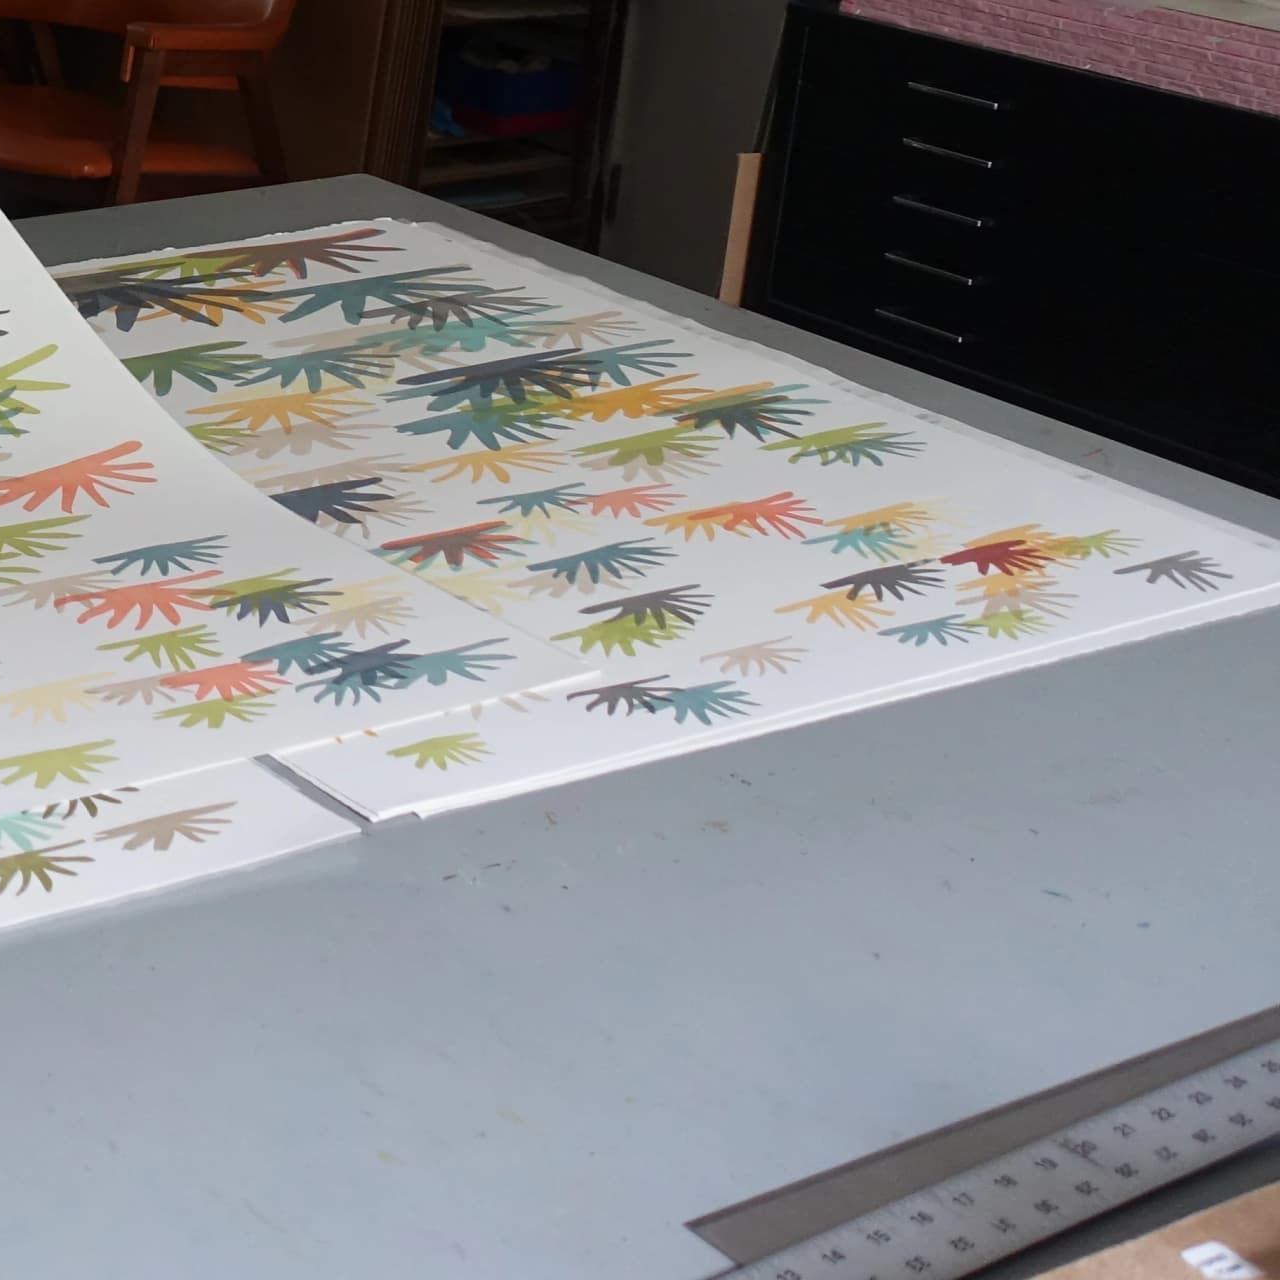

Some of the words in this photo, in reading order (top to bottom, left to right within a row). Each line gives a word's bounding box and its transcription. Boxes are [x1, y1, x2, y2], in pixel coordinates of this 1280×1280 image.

[821, 1249, 847, 1264] 14
[866, 1229, 892, 1245] 15
[910, 1210, 935, 1226] 16
[952, 1192, 975, 1207] 17
[993, 1174, 1019, 1188] 18
[1034, 1157, 1059, 1170] 19
[1072, 1140, 1097, 1158] 20
[1113, 1123, 1137, 1138] 21
[1152, 1107, 1176, 1122] 22
[1187, 1091, 1213, 1105] 23
[1223, 1075, 1248, 1089] 24
